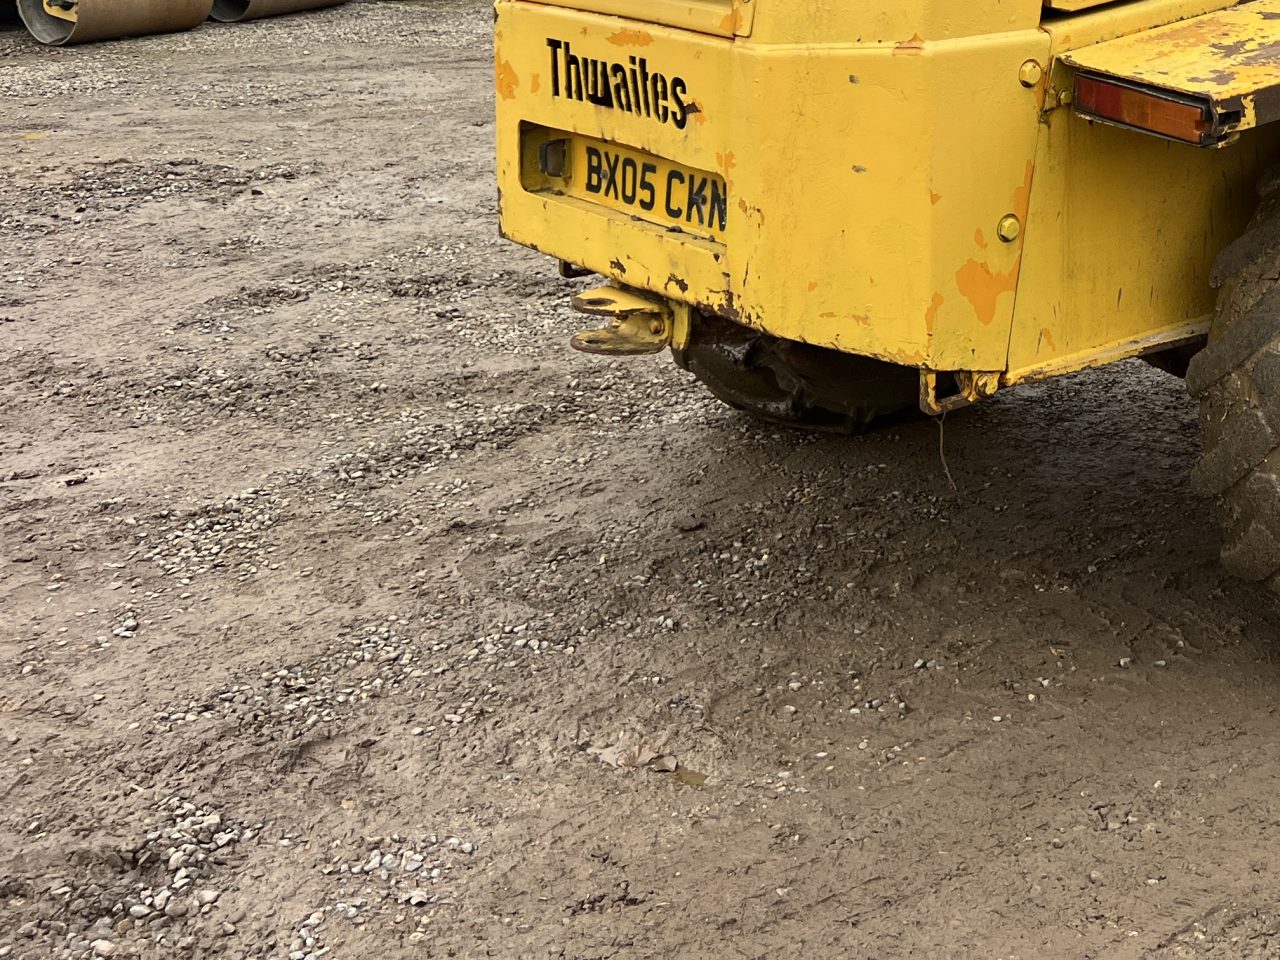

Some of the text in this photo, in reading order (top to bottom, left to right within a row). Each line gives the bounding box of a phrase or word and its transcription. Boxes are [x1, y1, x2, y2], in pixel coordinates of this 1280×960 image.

[546, 37, 687, 130] Thwaites
[586, 146, 727, 232] BX05 CKN
